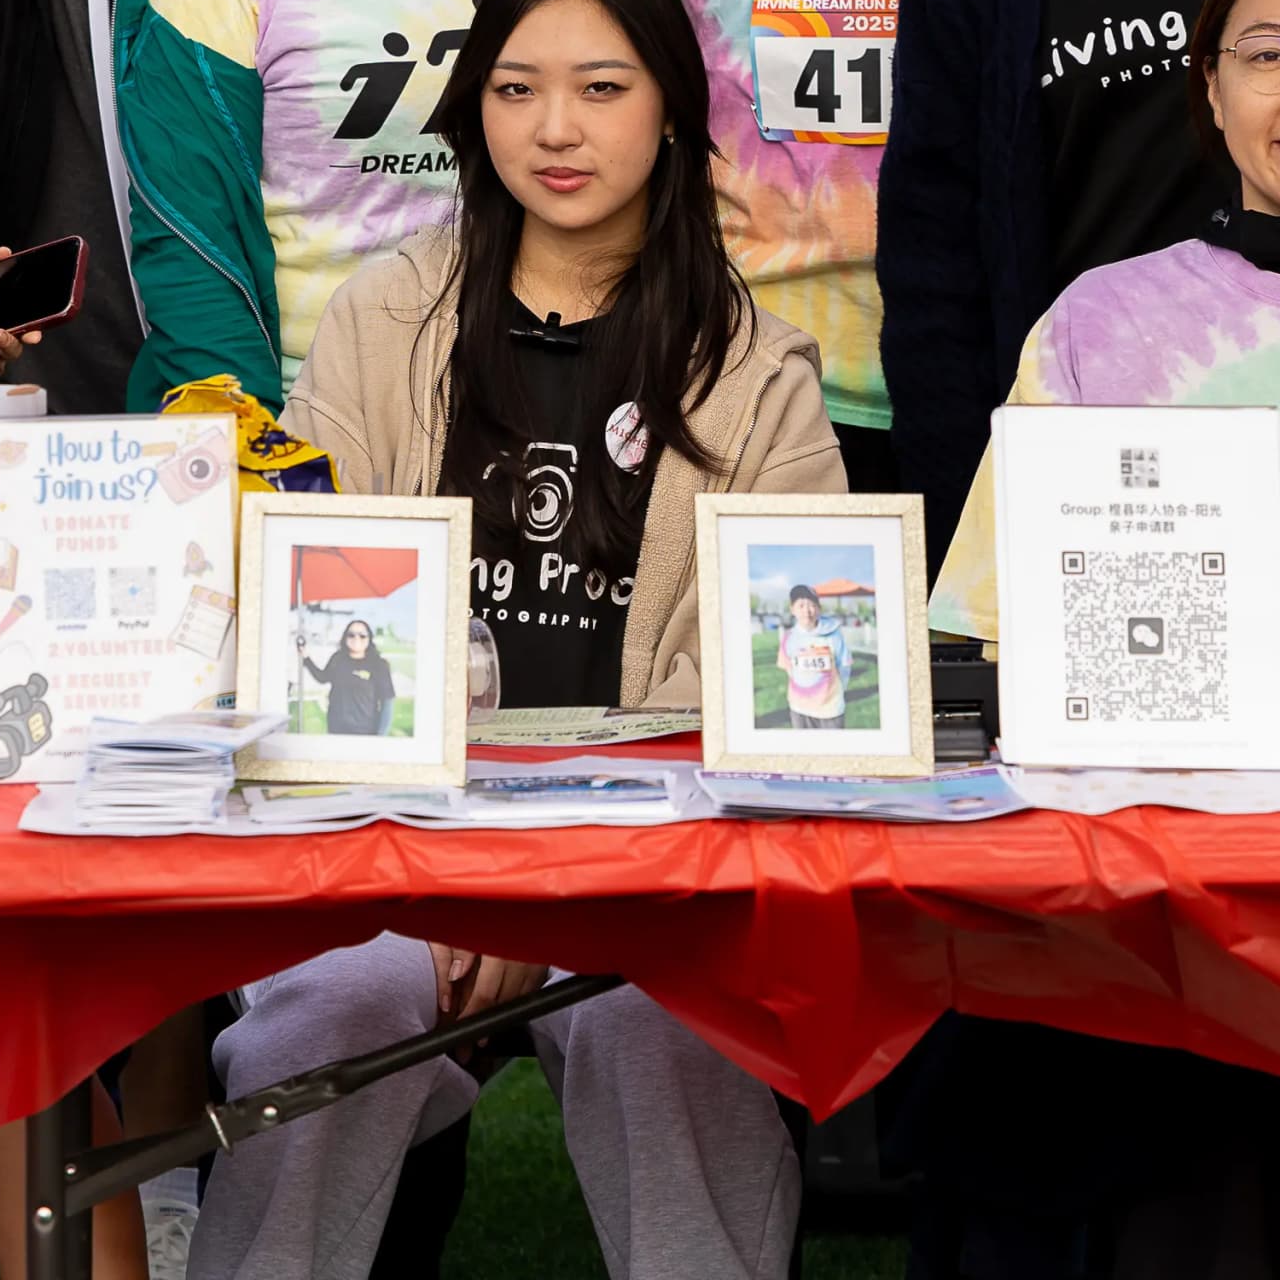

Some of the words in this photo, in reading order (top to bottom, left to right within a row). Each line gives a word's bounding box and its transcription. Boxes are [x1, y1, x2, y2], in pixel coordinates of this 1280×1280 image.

[756, 0, 800, 10] IRVINE
[855, 0, 885, 10] RUN
[842, 15, 896, 31] 2025
[361, 151, 458, 174] DREAM
[47, 431, 103, 466] How
[111, 429, 142, 464] to
[99, 467, 158, 504] us?
[1060, 503, 1104, 517] Group:
[55, 514, 130, 531] DONATE
[56, 535, 119, 552] FUNDS
[539, 552, 635, 606] Proo
[64, 639, 177, 656] VOLUNTEER
[64, 693, 143, 710] SERVICE
